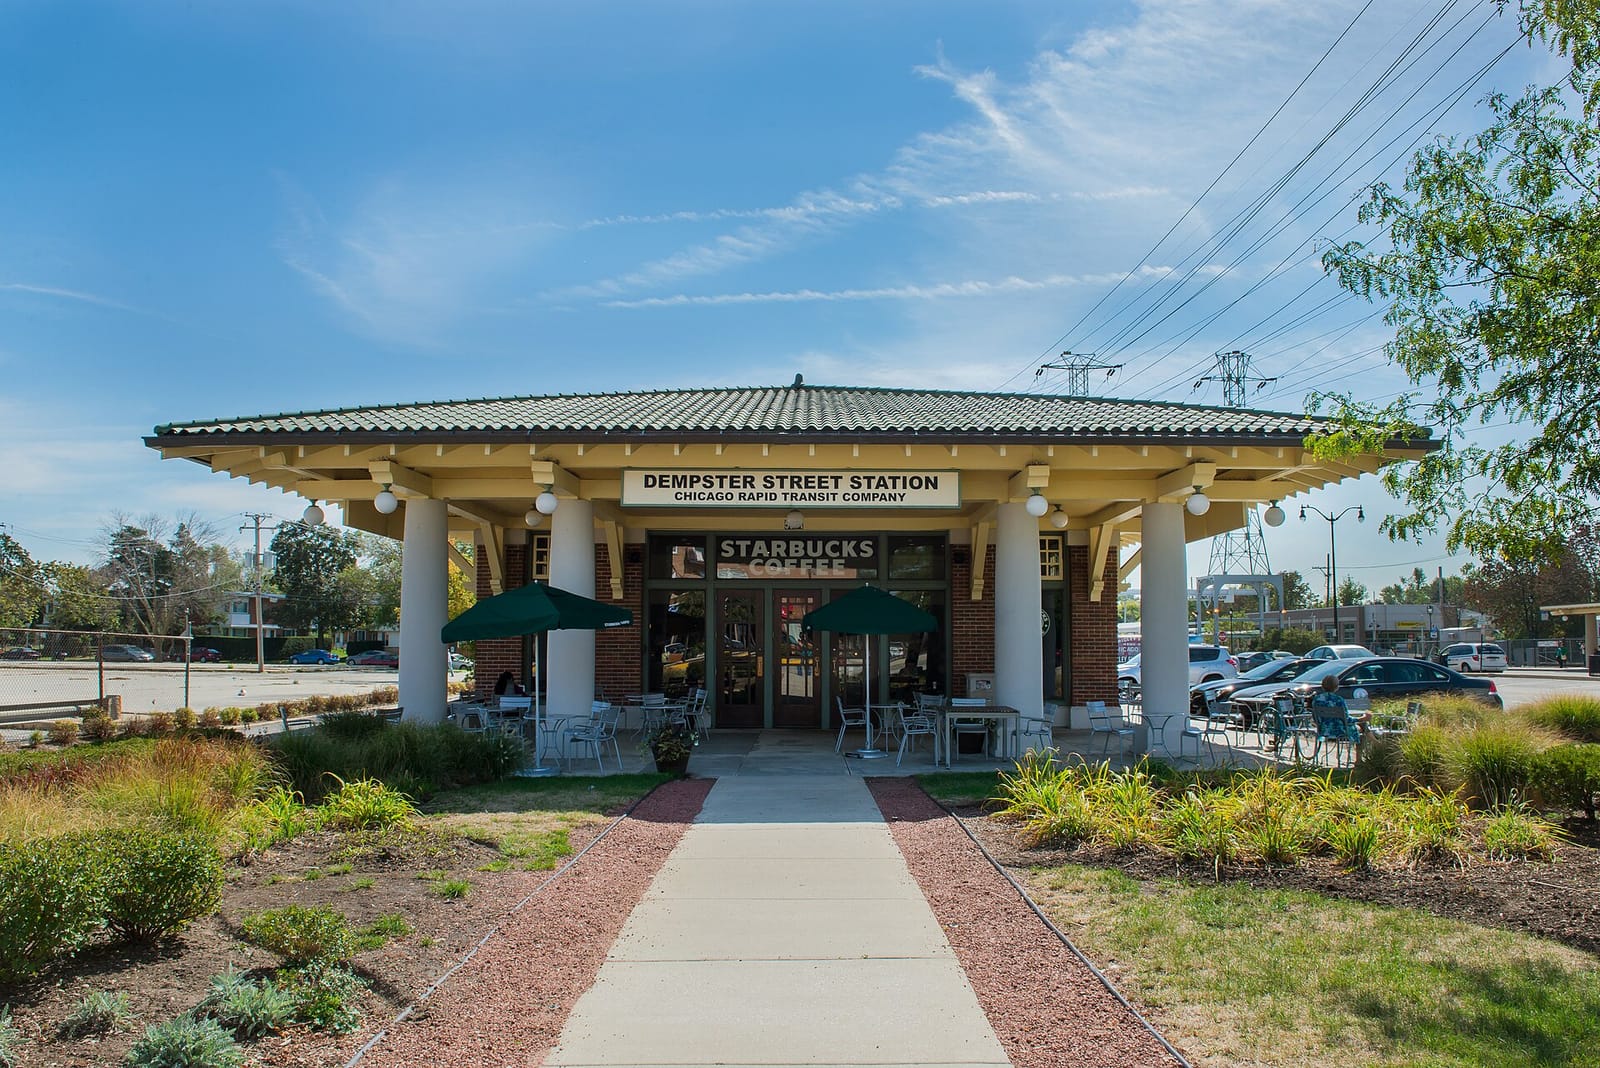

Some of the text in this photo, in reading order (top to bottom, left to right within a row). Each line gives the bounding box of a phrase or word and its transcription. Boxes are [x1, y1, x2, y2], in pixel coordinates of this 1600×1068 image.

[644, 474, 939, 490] DEMPSTER STREET STATION
[674, 491, 906, 502] CHICAGO RAPID TRANSIT COMPANY
[720, 540, 874, 558] STARBUCKS
[749, 558, 846, 576] COFFEE
